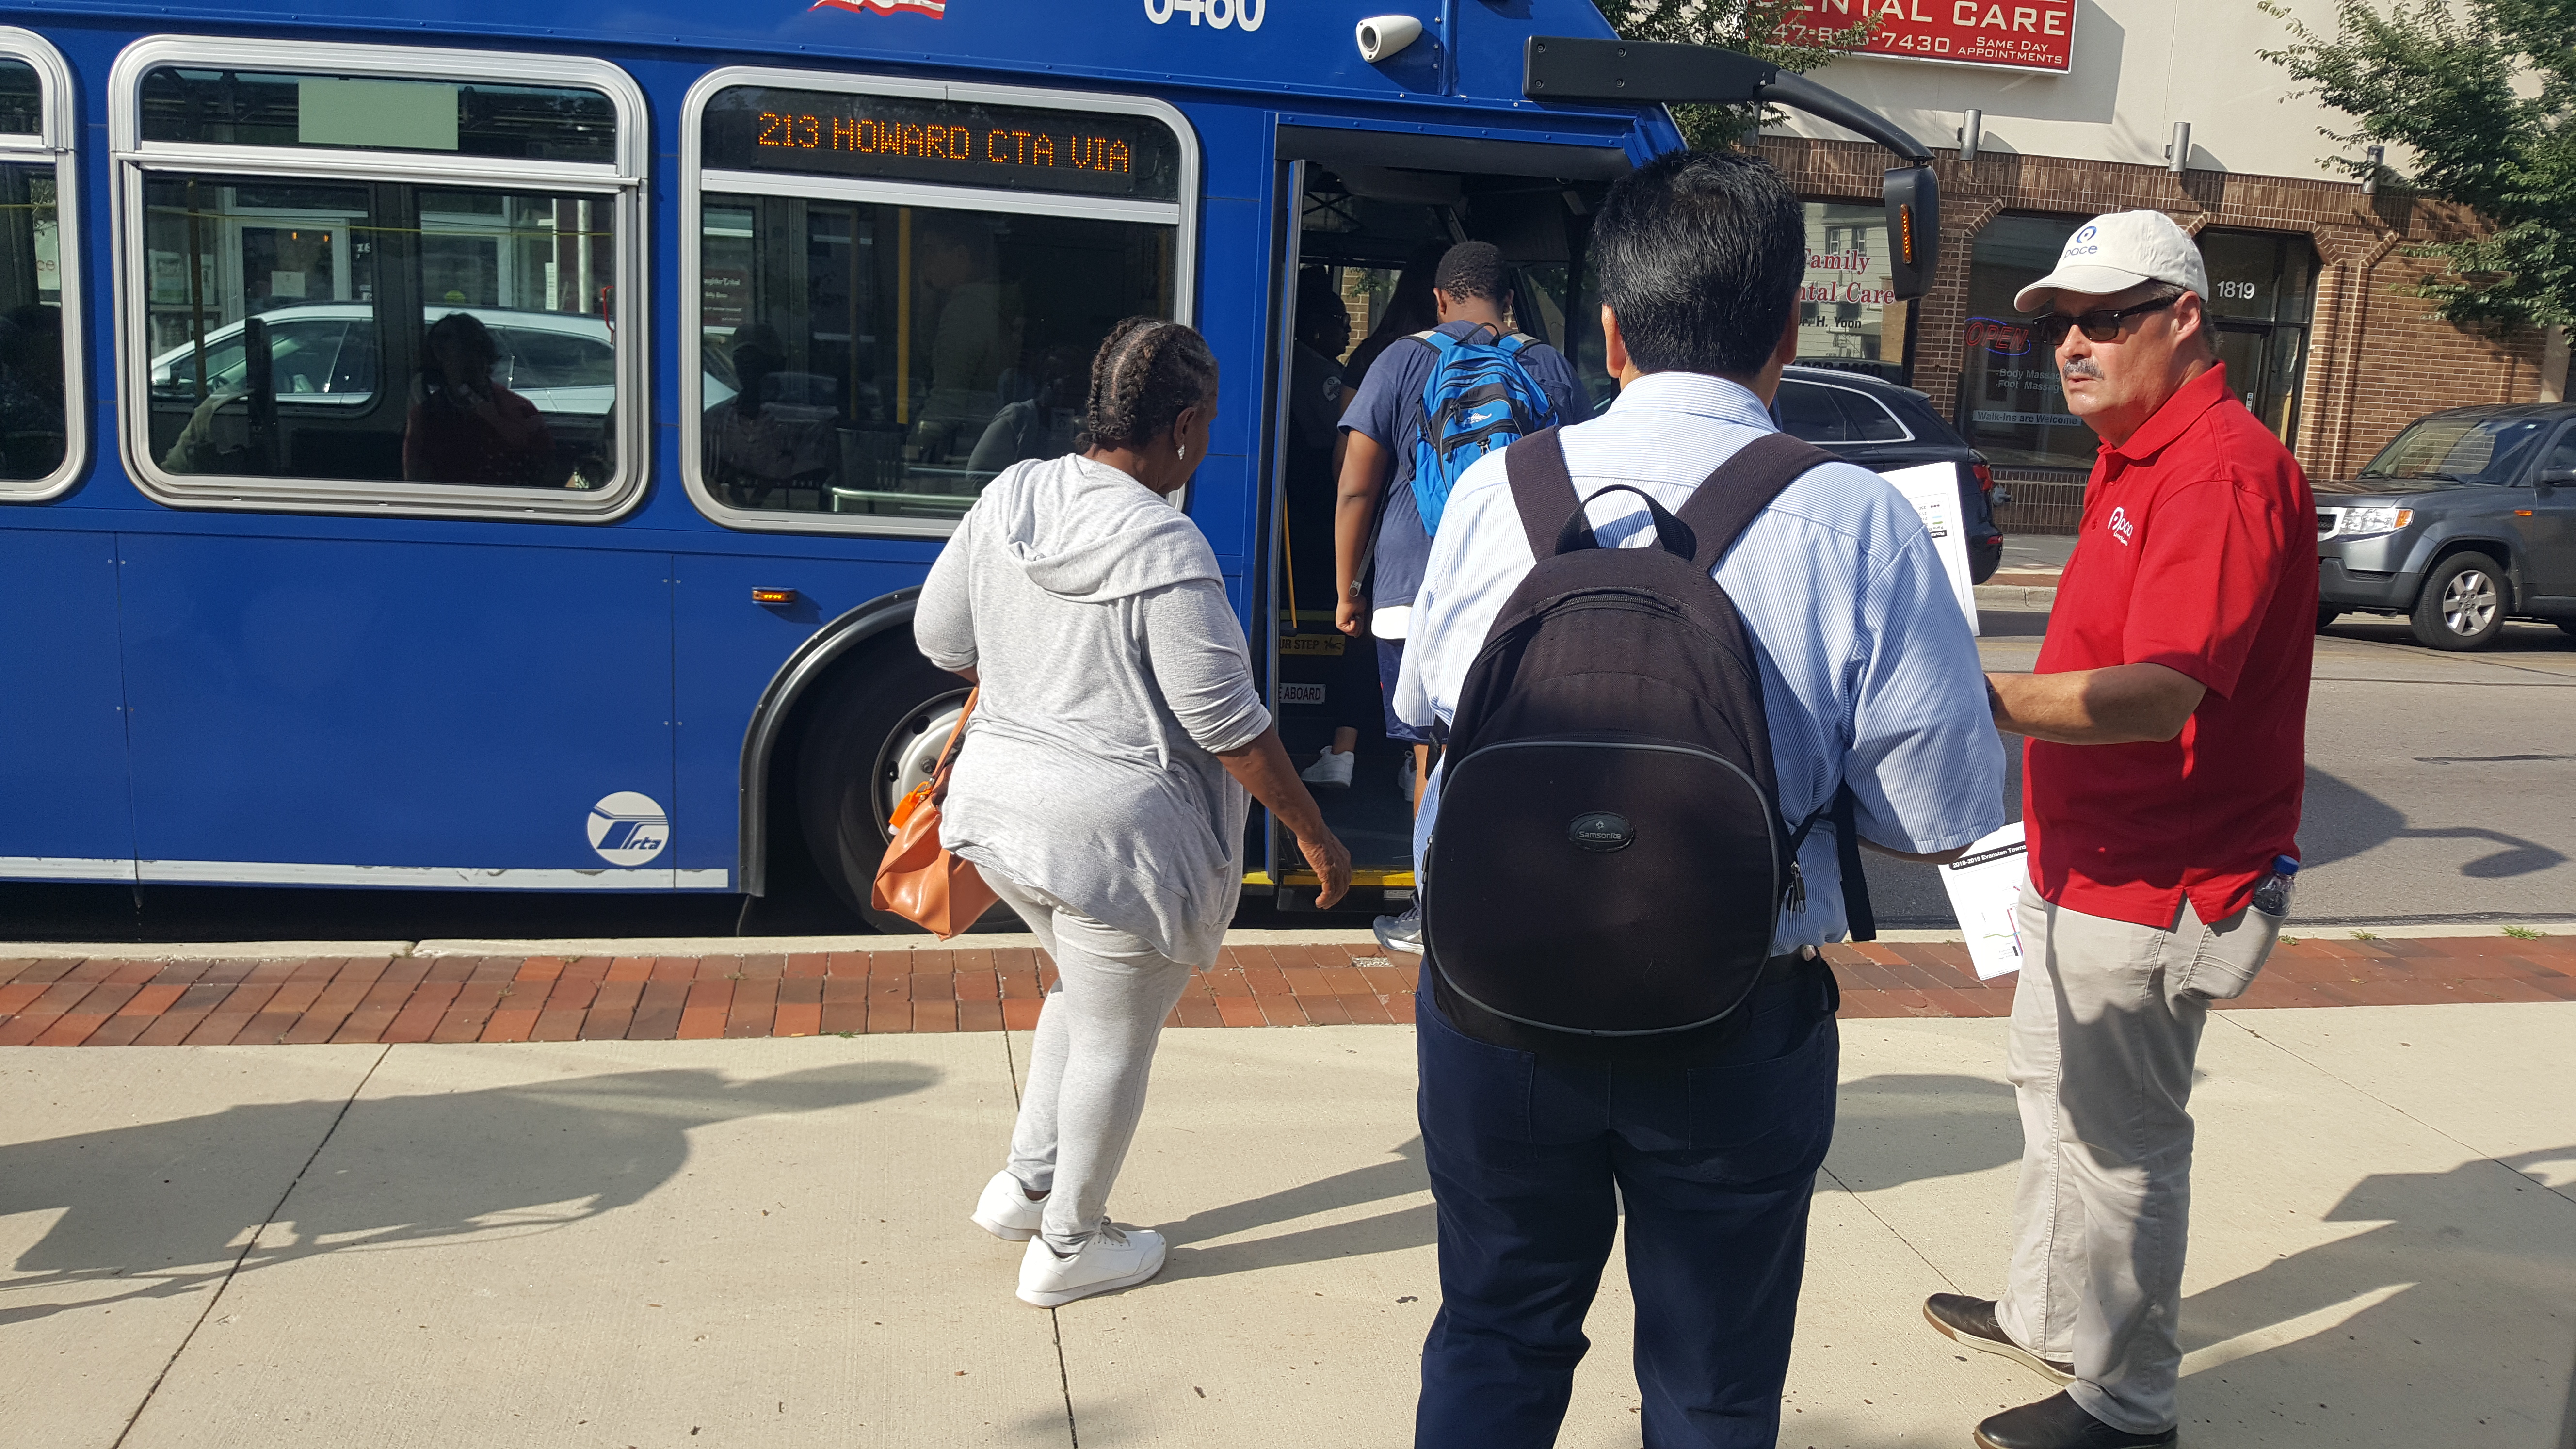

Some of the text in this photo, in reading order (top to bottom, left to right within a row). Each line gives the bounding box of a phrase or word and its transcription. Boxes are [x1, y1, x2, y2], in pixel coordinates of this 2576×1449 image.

[1952, 0, 2067, 36] CARE
[1957, 47, 2062, 64] APPOINTMENTS
[758, 113, 1130, 172] 213 HOWARD CTA VIA
[2063, 245, 2098, 261] pace
[1846, 282, 1895, 304] Care
[2217, 281, 2255, 299] 1819
[1966, 322, 2028, 350] OPEN
[1978, 411, 2077, 425] Walk-Ins are Welcome
[1294, 639, 1320, 649] STEP
[1284, 686, 1321, 700] ABOARD
[1952, 856, 1981, 868] 2018-2019
[1981, 850, 2007, 860] Evanston
